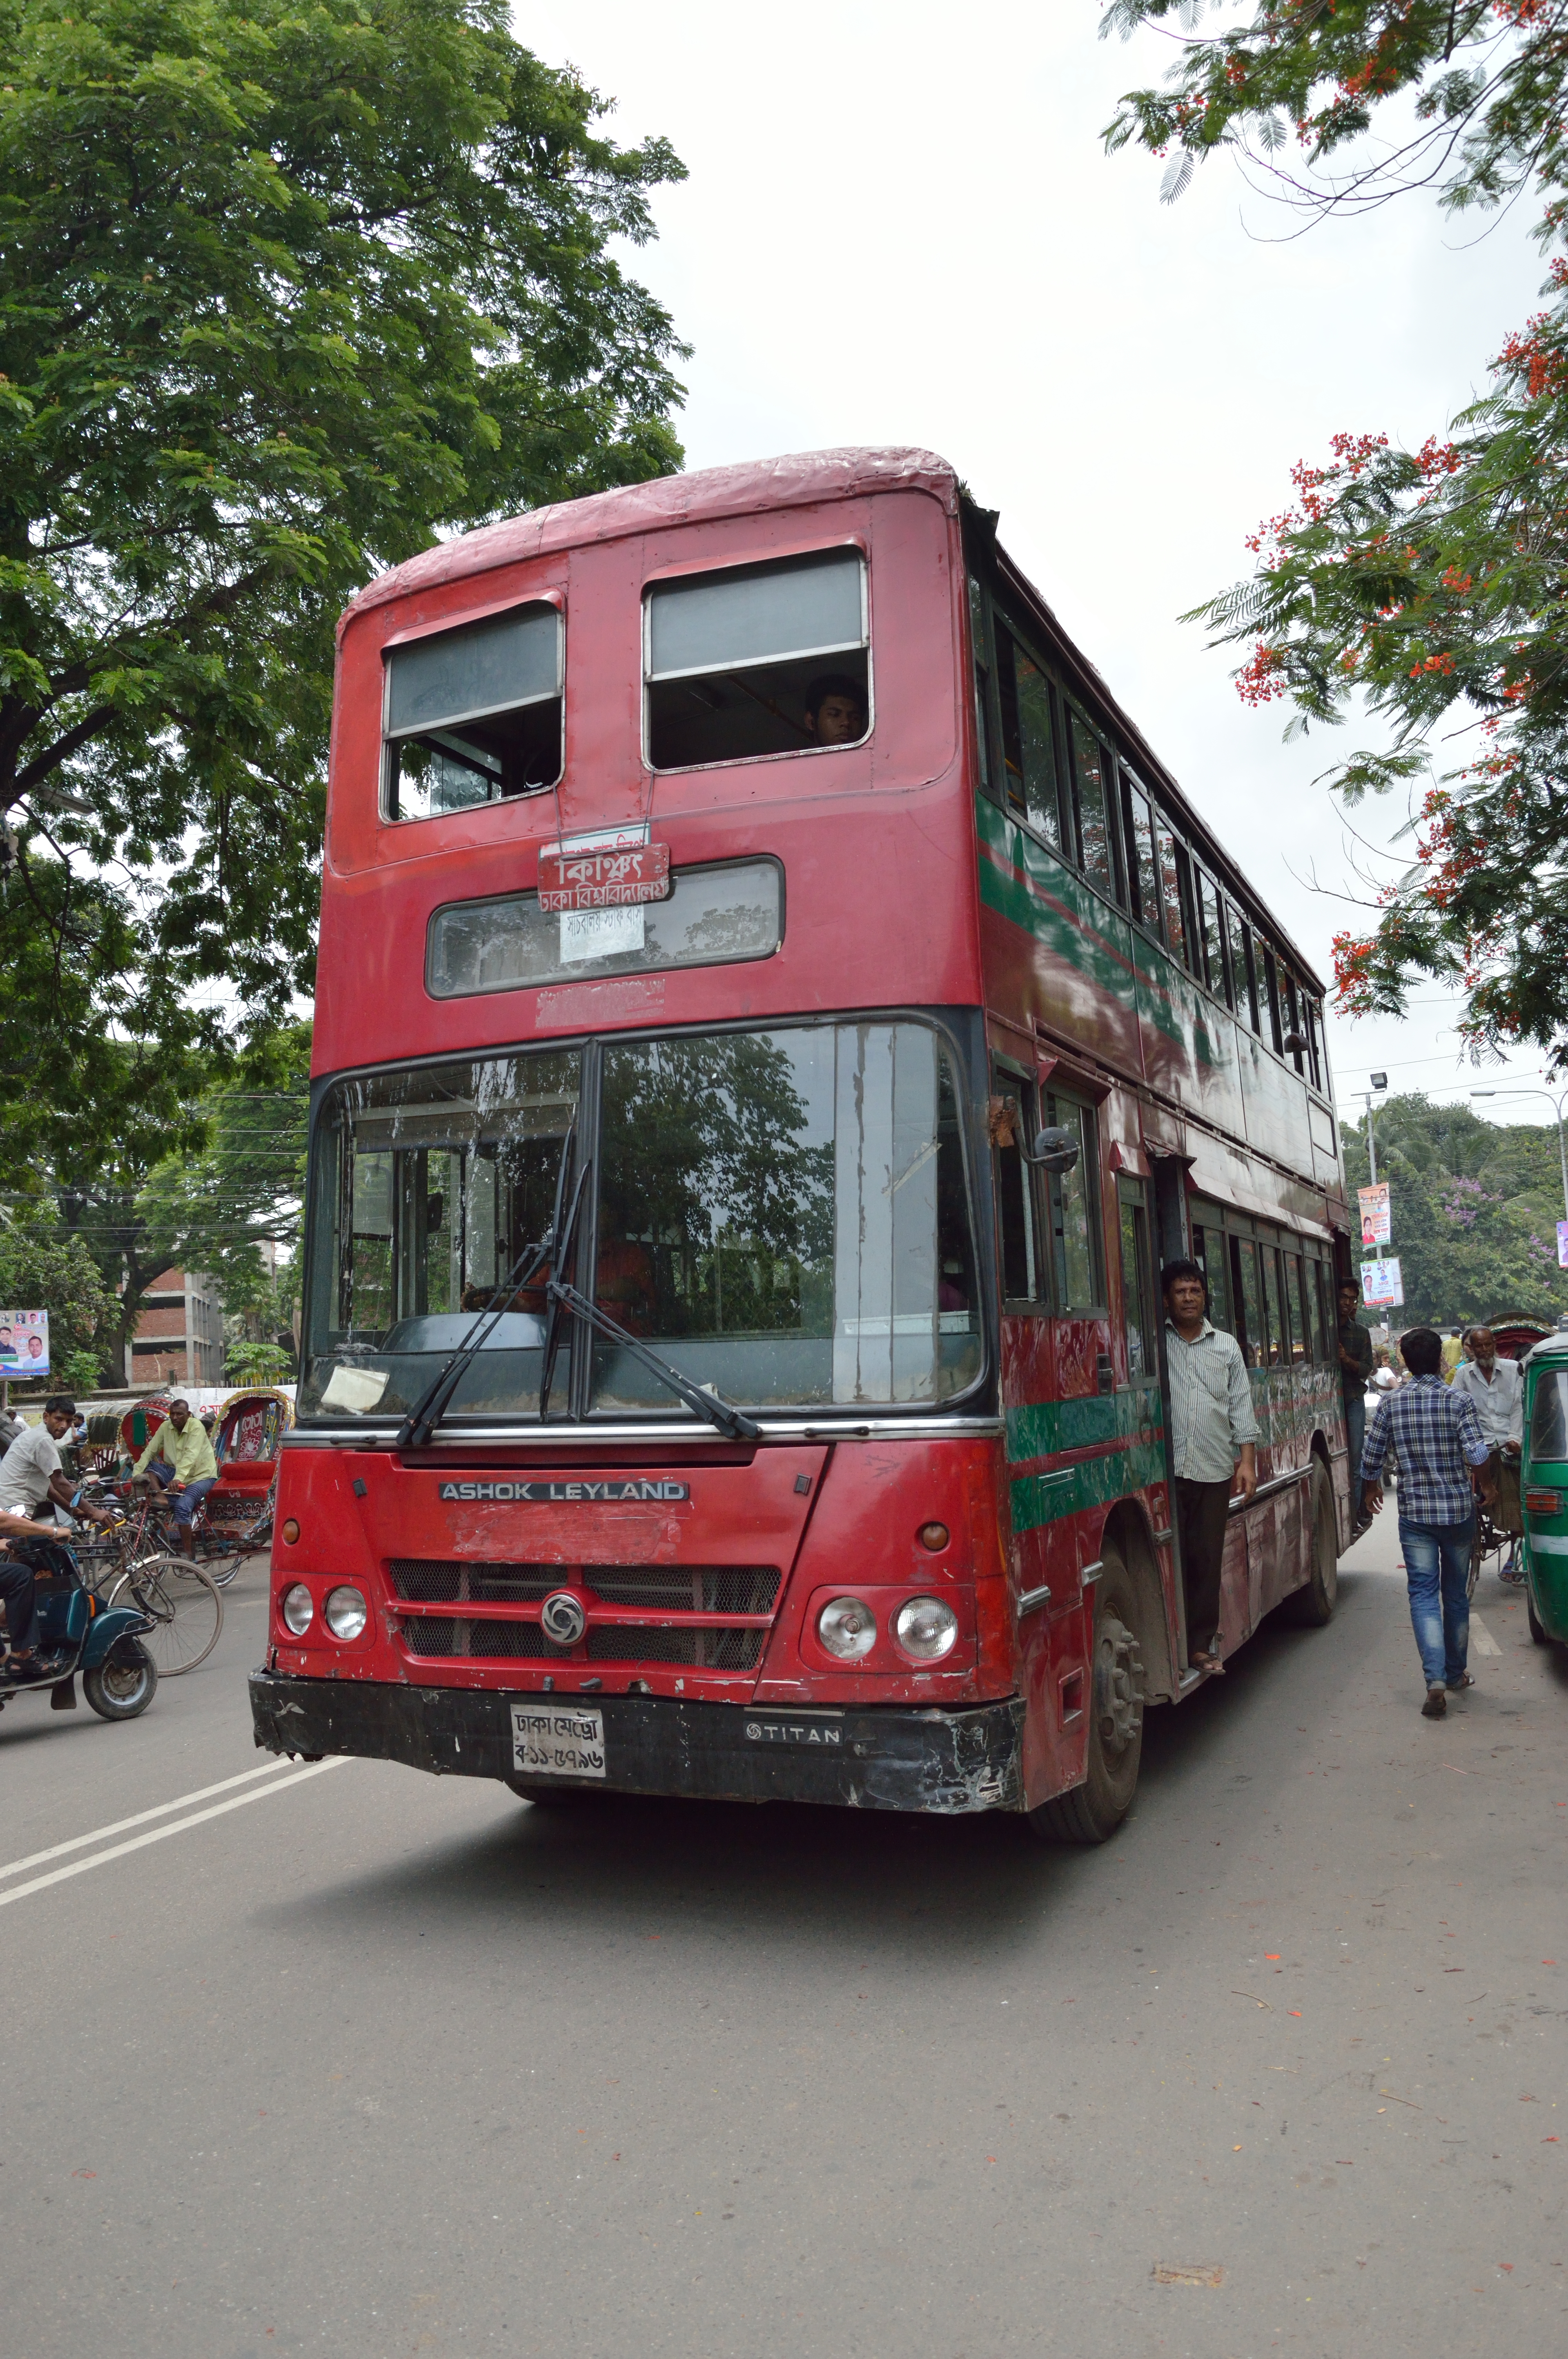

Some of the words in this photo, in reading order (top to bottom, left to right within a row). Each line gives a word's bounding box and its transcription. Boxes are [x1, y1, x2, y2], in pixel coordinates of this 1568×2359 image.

[538, 891, 573, 912] ঢাকা
[443, 1483, 532, 1499] ASHOK
[550, 1483, 685, 1500] LEYLAND
[514, 1714, 551, 1735] ঢাকা
[554, 1712, 597, 1741] মেট্রো
[764, 1726, 840, 1743] TITAN
